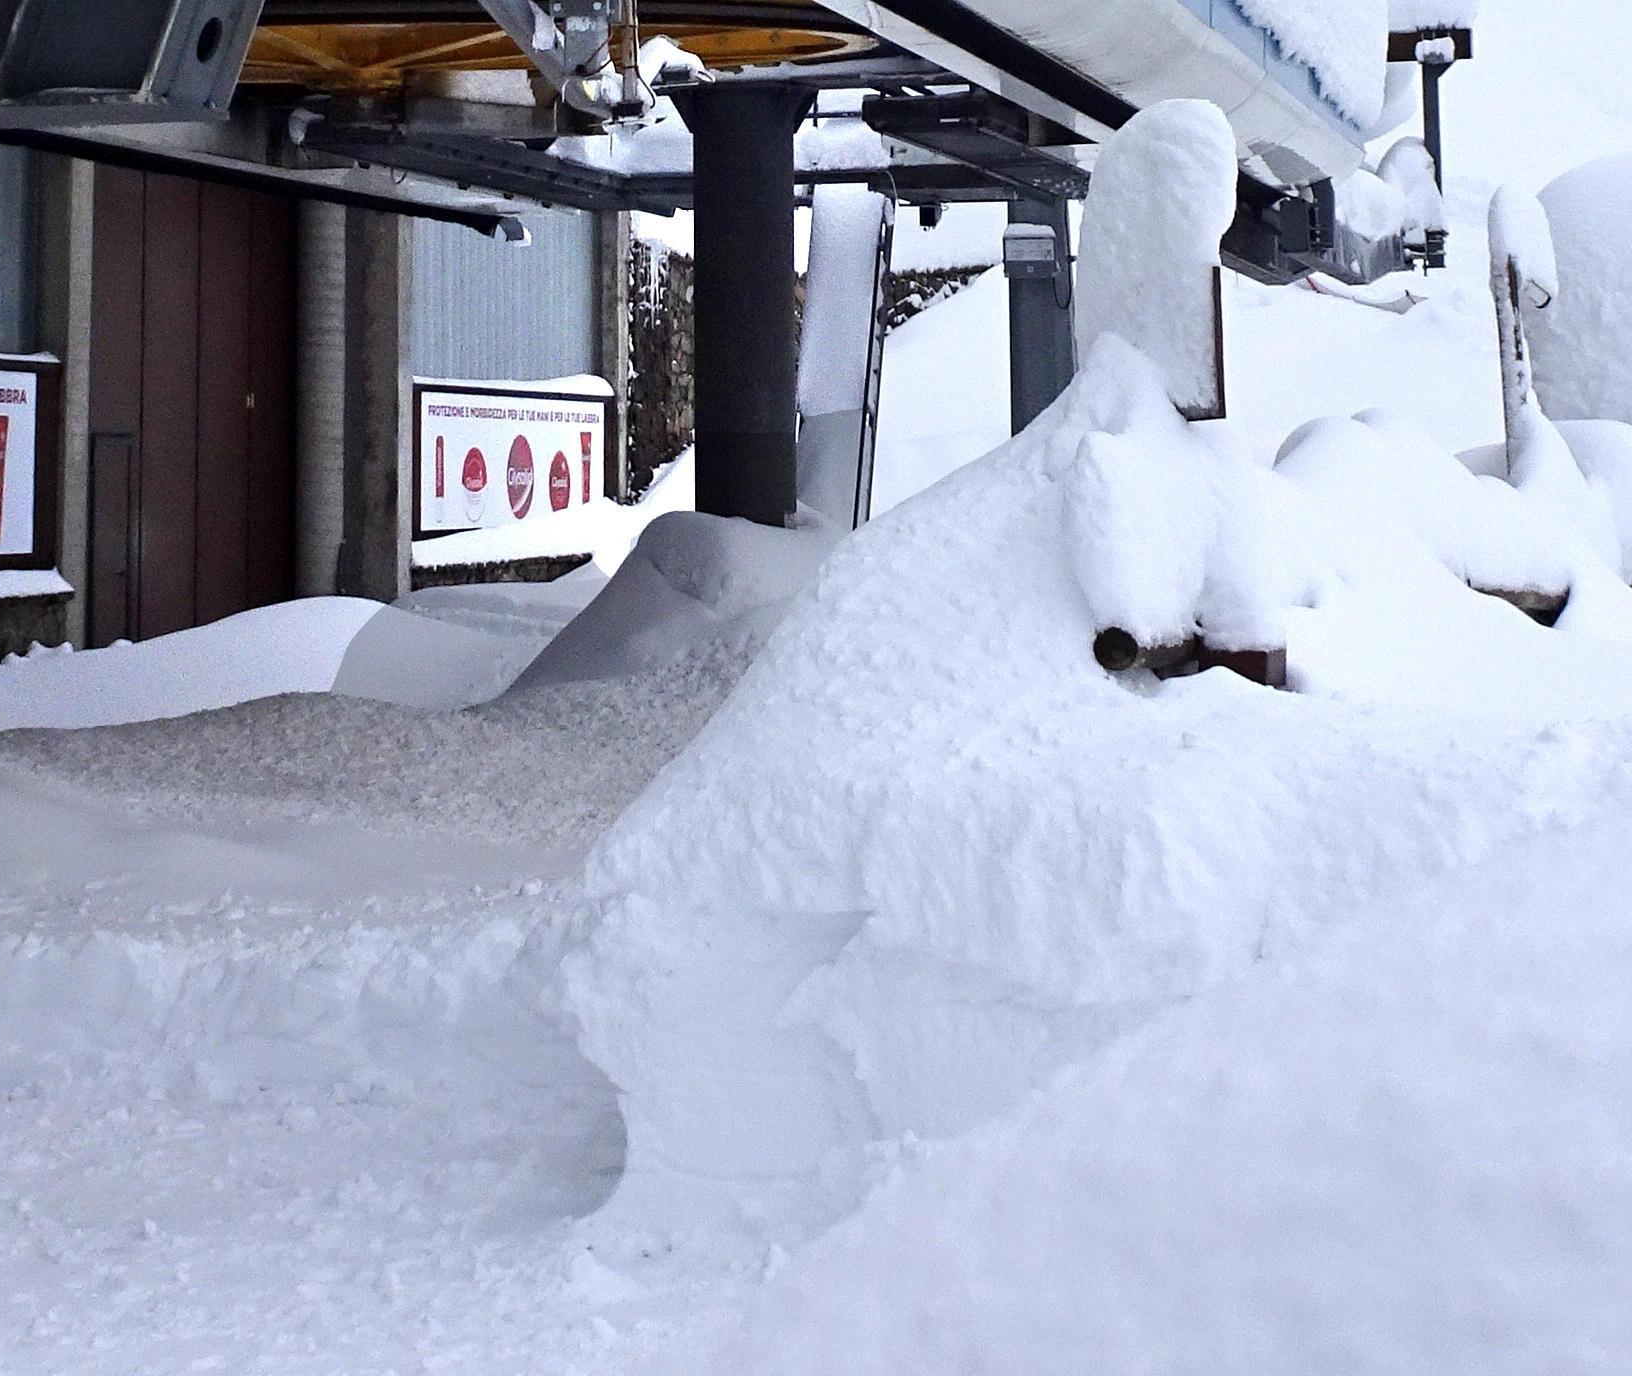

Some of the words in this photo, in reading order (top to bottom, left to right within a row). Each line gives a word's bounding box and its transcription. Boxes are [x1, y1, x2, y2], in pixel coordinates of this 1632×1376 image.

[428, 405, 464, 417] PROTEZIONE
[508, 409, 517, 420] PER
[526, 410, 535, 421] TUE
